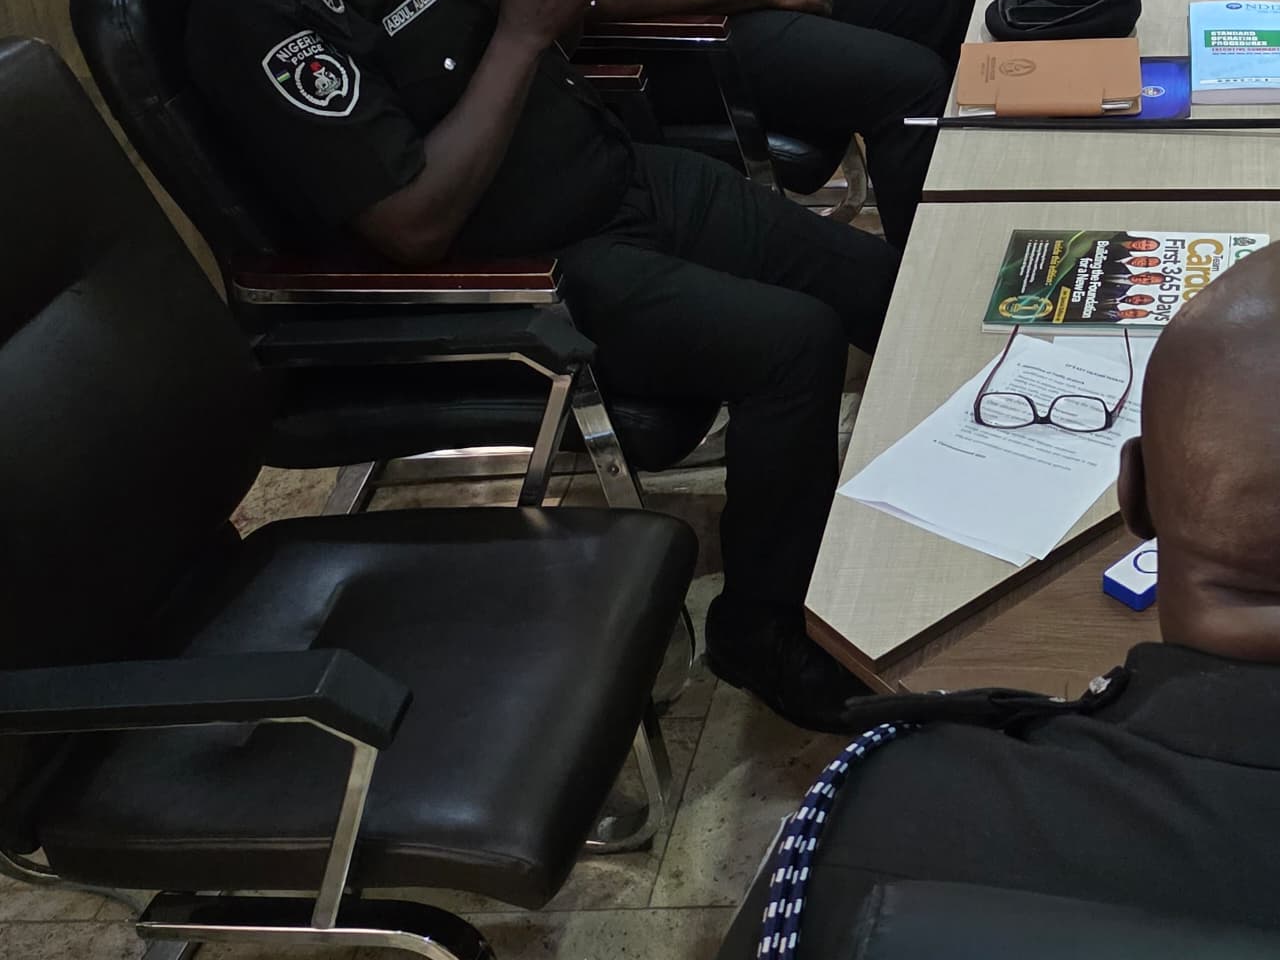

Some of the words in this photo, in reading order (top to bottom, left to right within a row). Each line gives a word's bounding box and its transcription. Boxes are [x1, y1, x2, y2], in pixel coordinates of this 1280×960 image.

[276, 32, 324, 63] NIGERIA
[291, 43, 325, 66] POLICE
[1079, 258, 1093, 269] for
[1090, 240, 1110, 269] Building
[1163, 238, 1186, 265] First
[1211, 255, 1223, 272] Team
[1073, 273, 1089, 291] New
[1089, 269, 1105, 281] the
[1160, 266, 1183, 292] 365
[1071, 291, 1085, 303] Era
[1081, 281, 1102, 319] Foundation
[1149, 294, 1180, 322] Days
